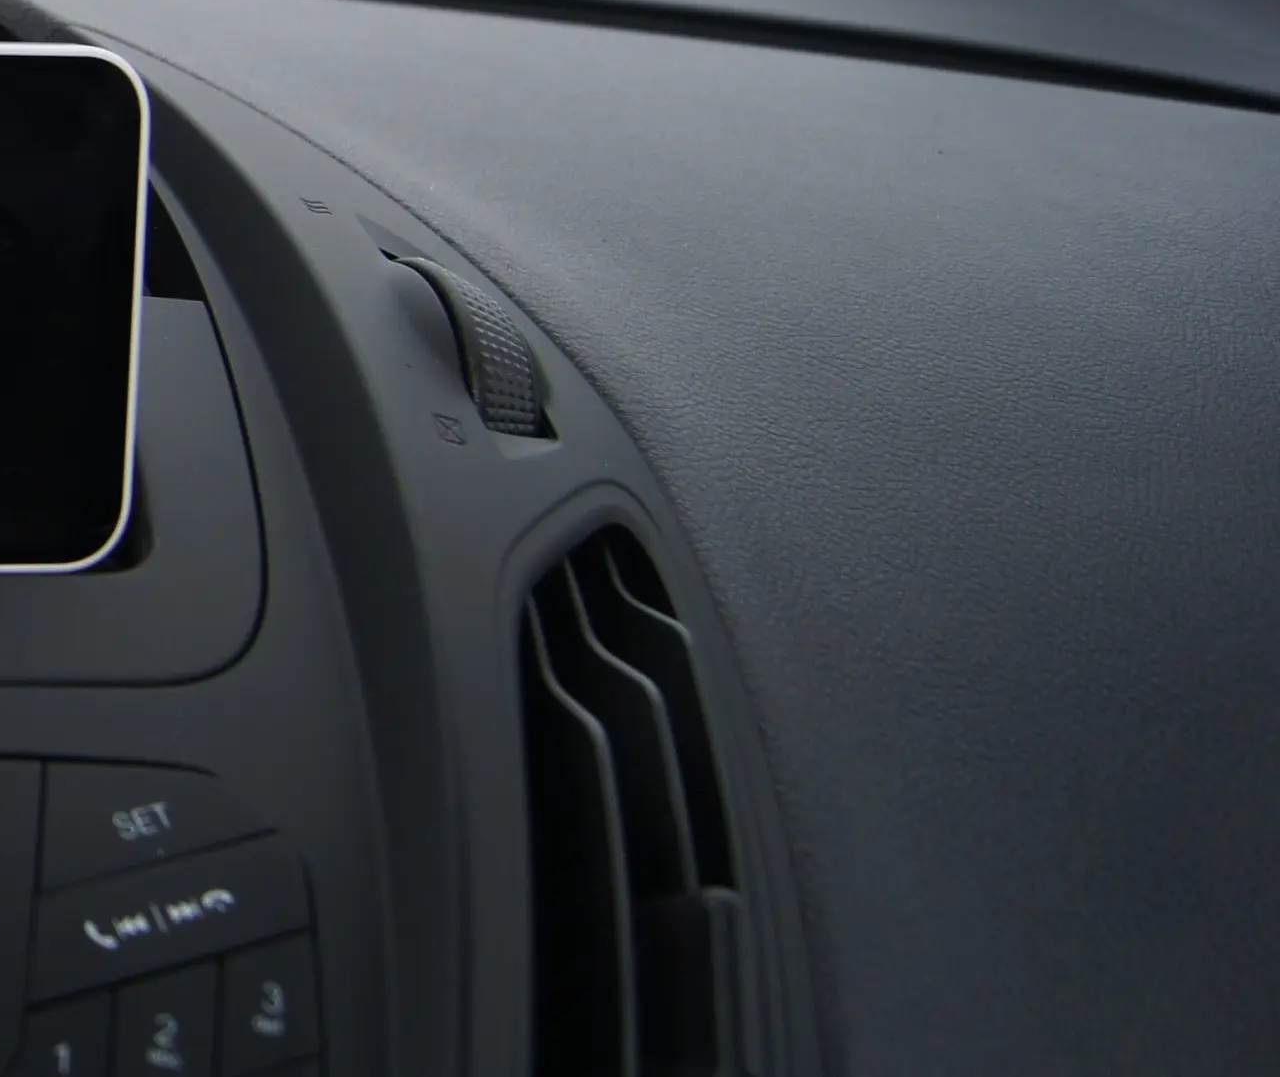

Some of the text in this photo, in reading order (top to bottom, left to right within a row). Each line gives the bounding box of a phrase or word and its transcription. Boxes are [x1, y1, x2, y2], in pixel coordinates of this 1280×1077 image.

[111, 802, 171, 840] SET
[261, 980, 285, 1016] 3
[152, 1012, 178, 1049] 2
